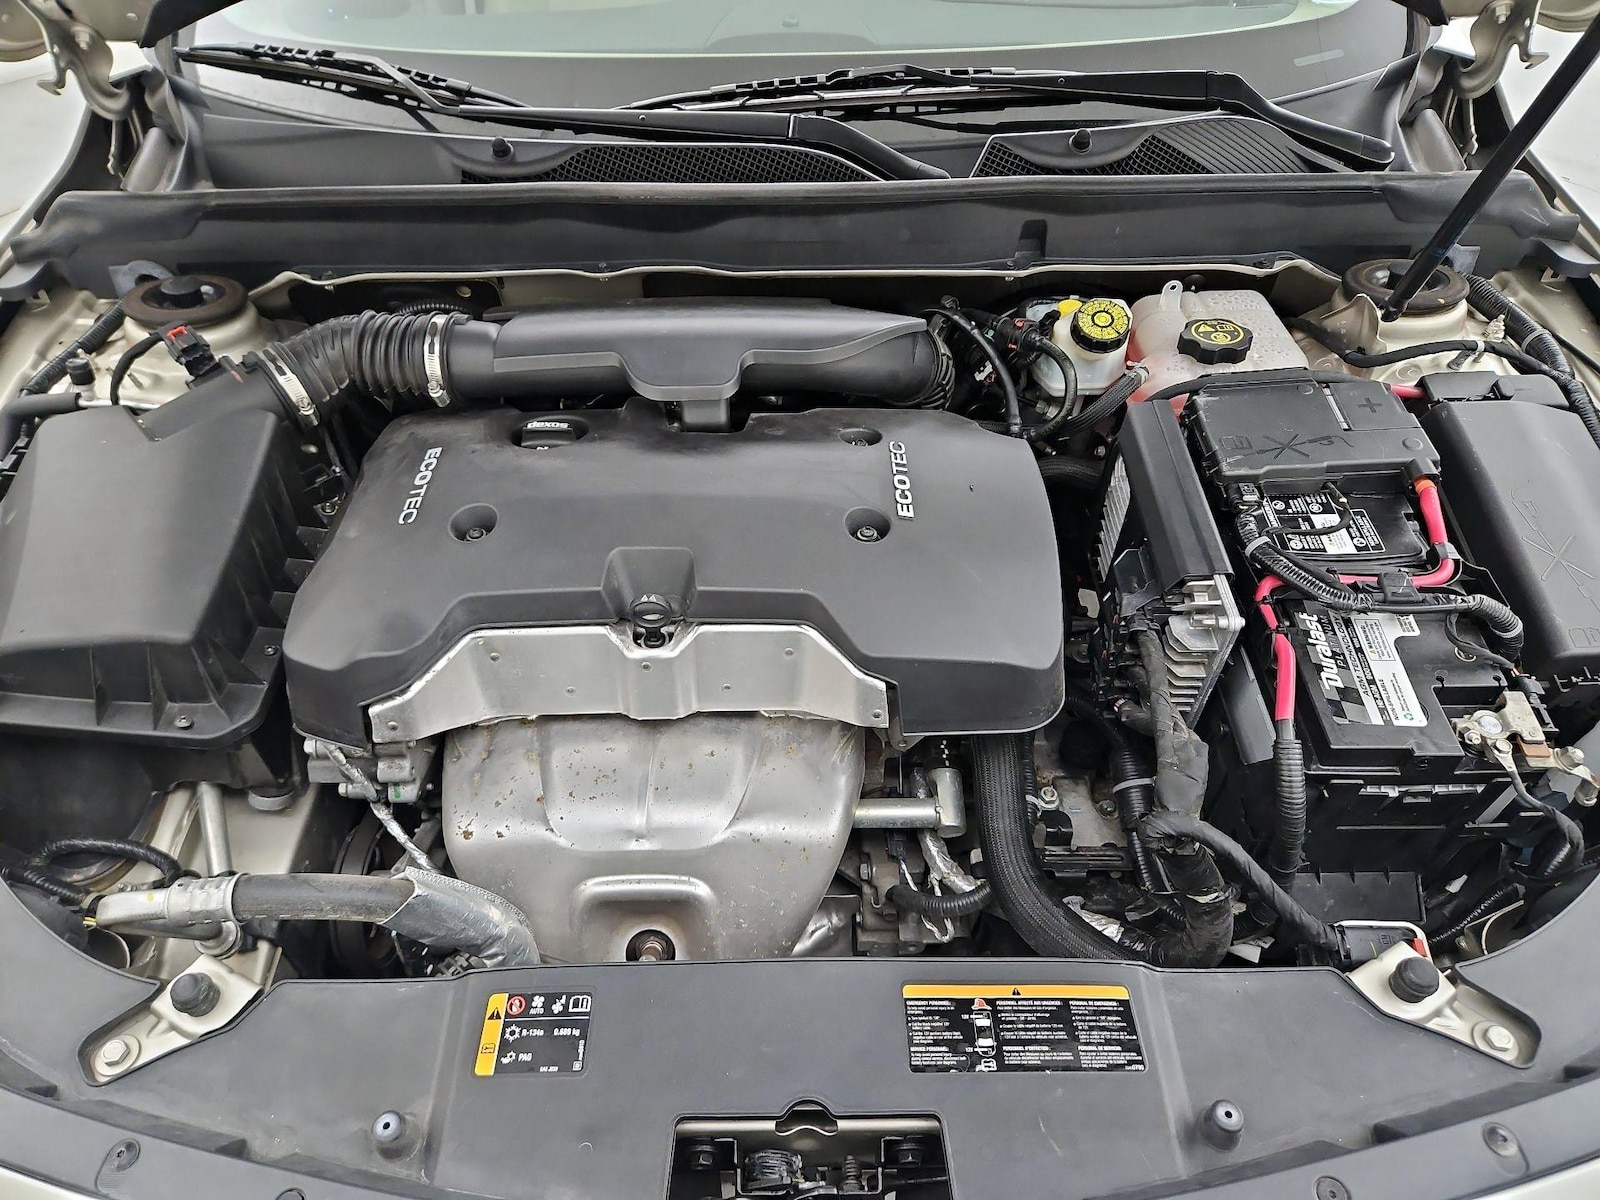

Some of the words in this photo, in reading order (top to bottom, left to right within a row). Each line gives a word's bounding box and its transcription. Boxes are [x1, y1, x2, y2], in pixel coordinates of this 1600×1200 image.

[527, 421, 570, 429] dexos
[398, 446, 443, 525] ECOTEC
[889, 440, 915, 519] ECOTEC
[1299, 611, 1344, 690] Duralast
[1319, 614, 1347, 667] PLATINUM
[1332, 615, 1361, 673] TECHNOLOGY
[1356, 675, 1371, 697] AGM
[518, 1052, 533, 1062] PAG
[572, 1027, 580, 1037] kg
